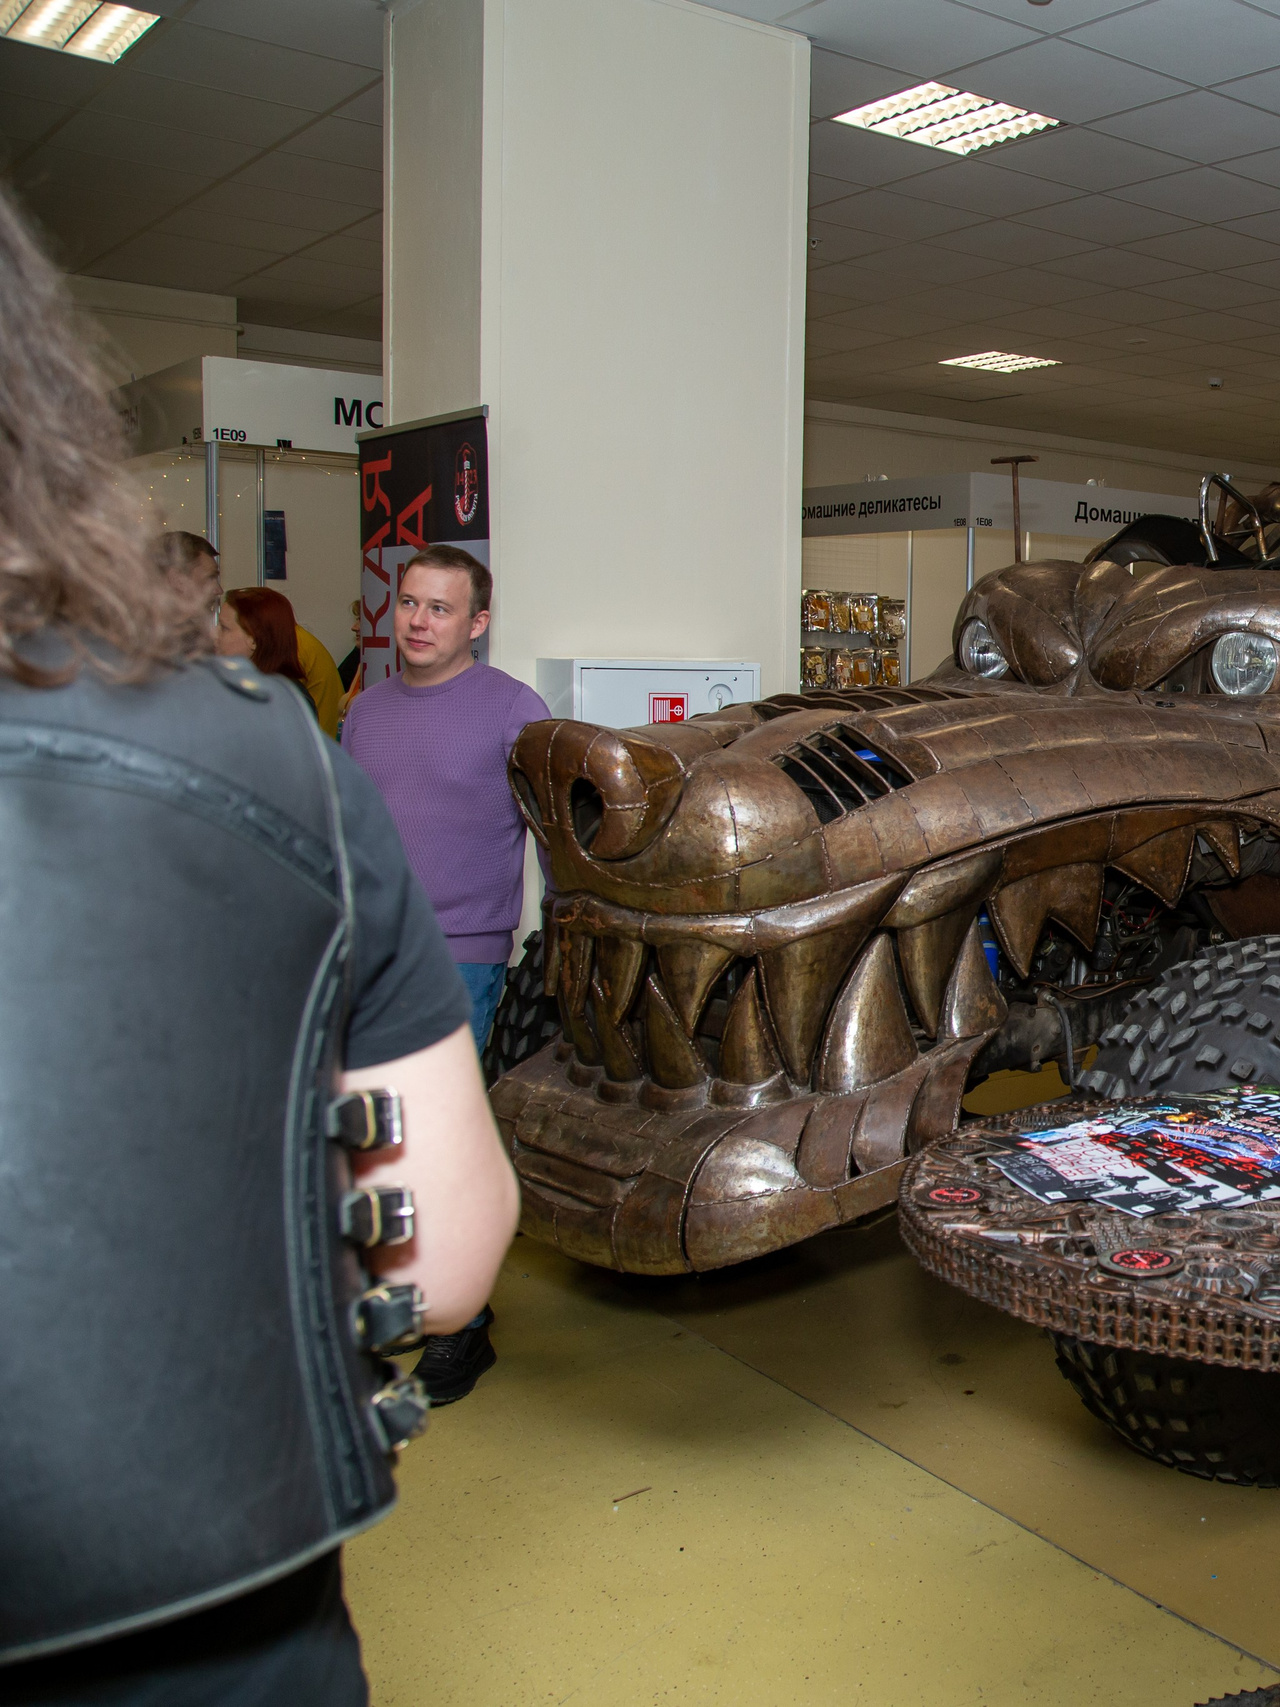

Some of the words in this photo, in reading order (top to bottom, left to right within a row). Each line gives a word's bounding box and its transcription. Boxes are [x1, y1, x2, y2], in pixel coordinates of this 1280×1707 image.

[212, 427, 247, 442] 1E09
[802, 500, 856, 521] омашние
[858, 493, 941, 519] деликатесы
[1074, 500, 1143, 524] Домаш
[975, 517, 994, 528] 1E08
